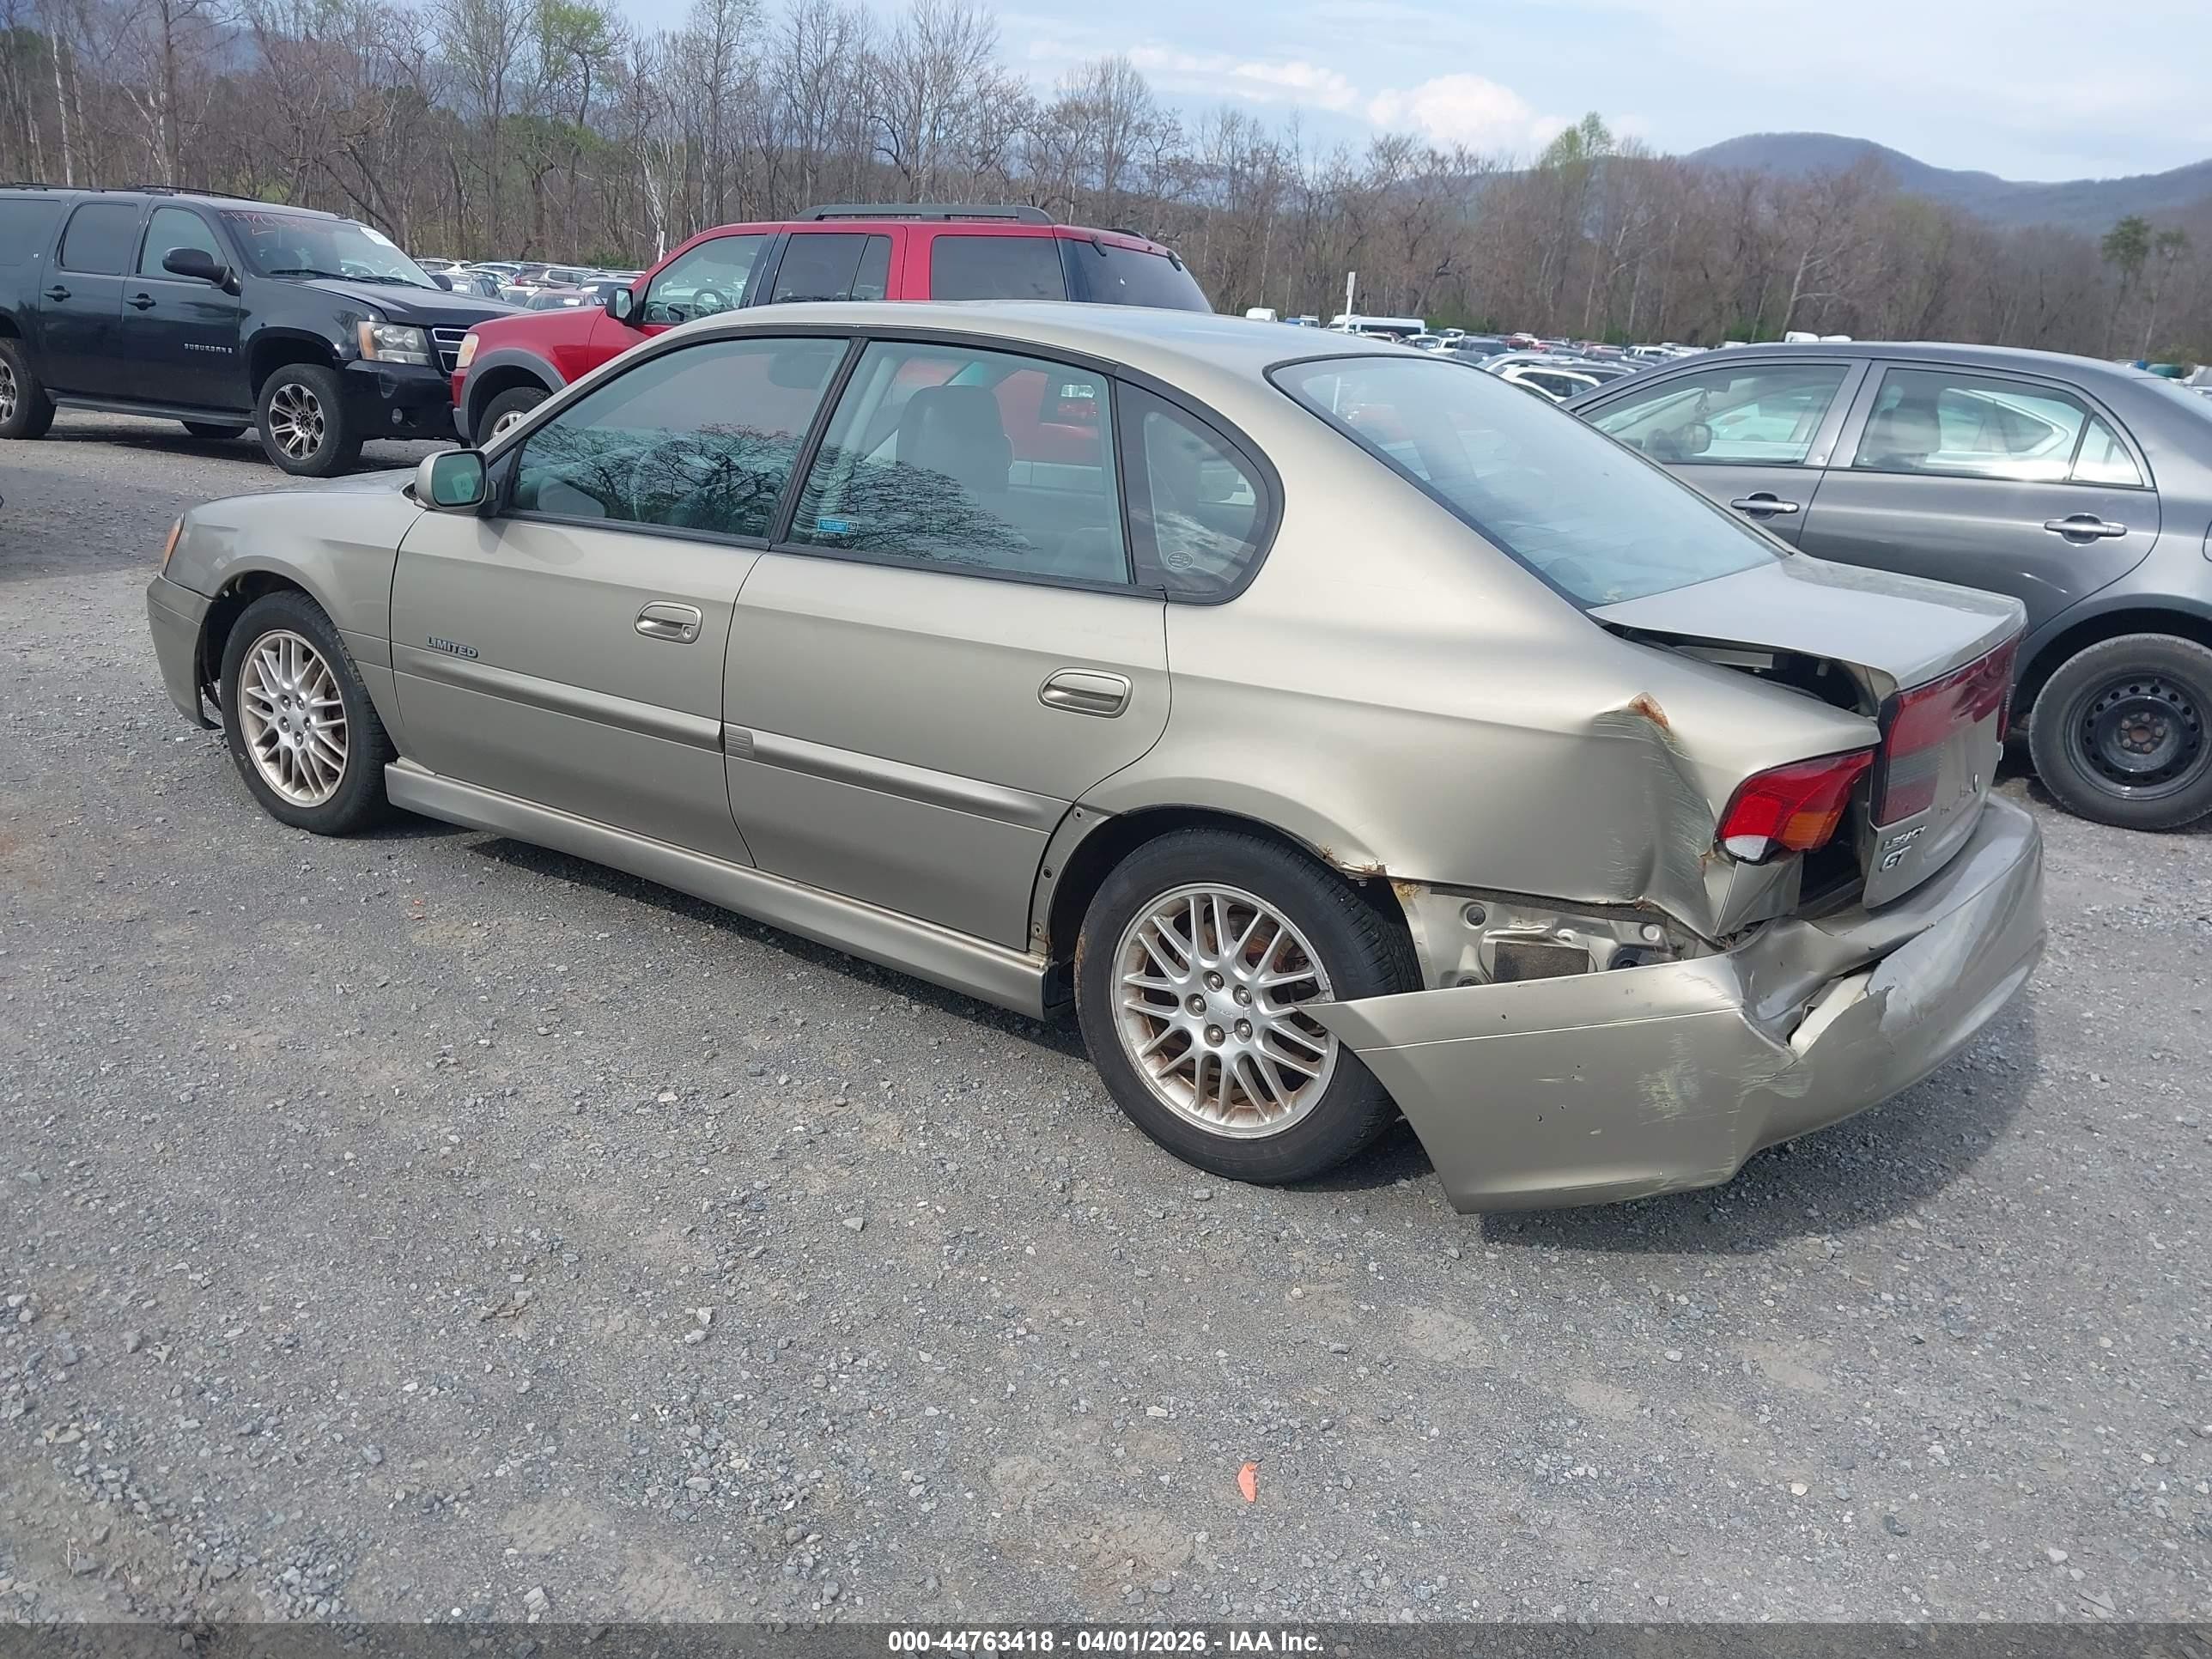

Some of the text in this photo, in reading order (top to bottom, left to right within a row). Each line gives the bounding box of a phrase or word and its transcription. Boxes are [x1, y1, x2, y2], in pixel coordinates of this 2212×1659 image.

[426, 636, 478, 659] LIMITED
[1881, 826, 1927, 851] LEGACY
[1881, 845, 1912, 871] GT
